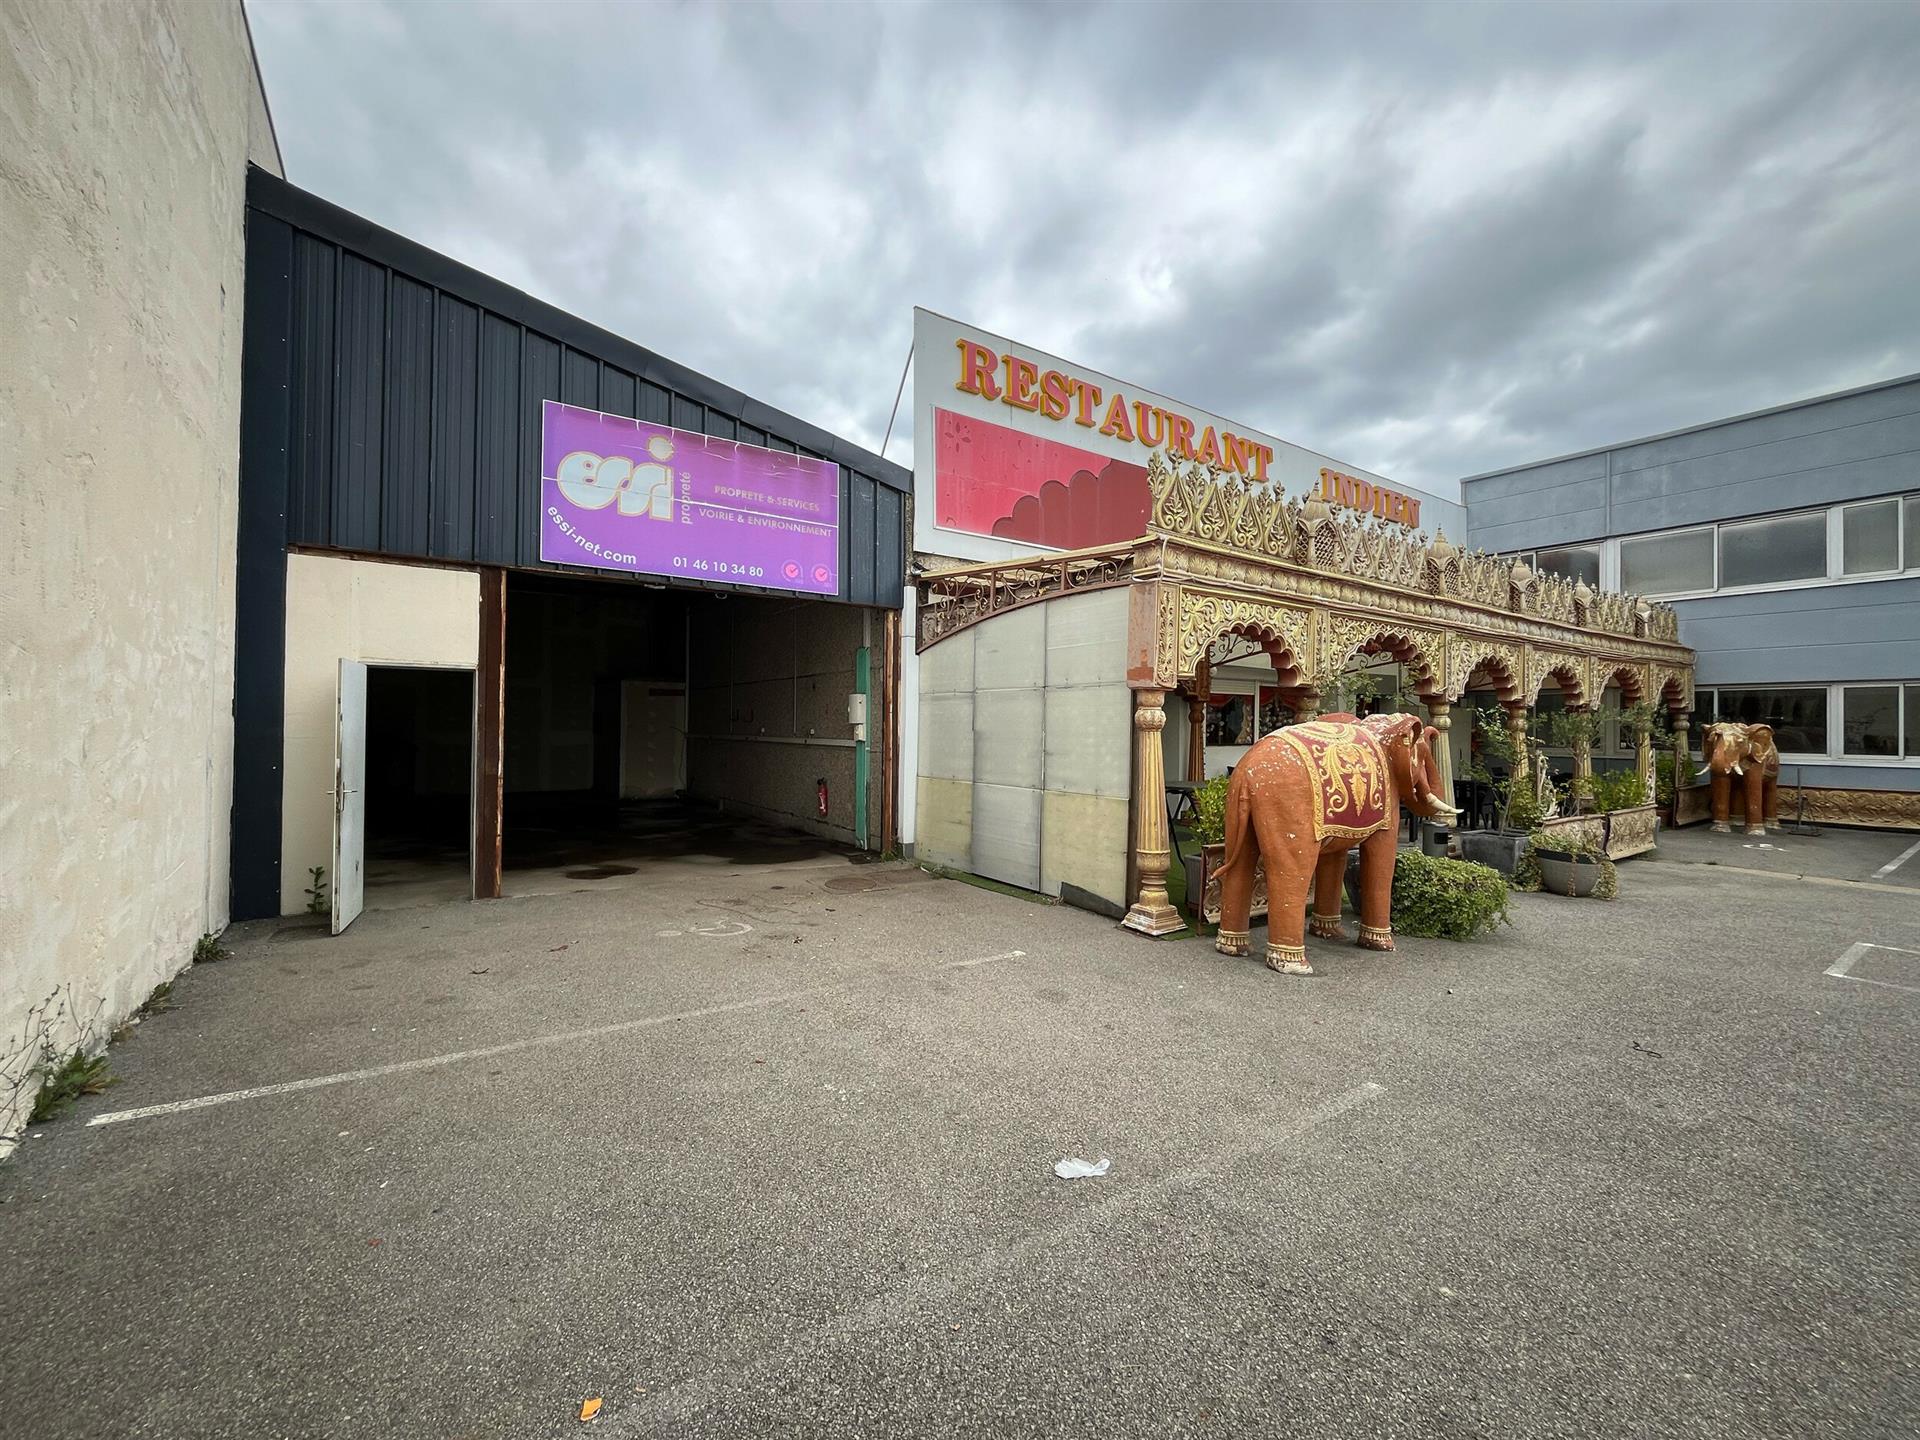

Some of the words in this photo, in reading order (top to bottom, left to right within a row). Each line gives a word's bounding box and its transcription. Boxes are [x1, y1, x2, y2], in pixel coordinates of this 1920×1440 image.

[955, 337, 1274, 483] RESTAURANT
[1319, 467, 1421, 530] INDIEN
[679, 471, 693, 525] propreté
[767, 494, 777, 504] &
[777, 496, 820, 512] SERVICES
[547, 506, 637, 565] essi-net.com
[699, 508, 734, 522] VOIRIE
[738, 514, 745, 523] &
[748, 516, 833, 537] ENVIRONNEMENT
[673, 556, 688, 568] 01
[693, 559, 708, 571] 46
[713, 561, 727, 573] 10
[731, 563, 746, 575] 34
[749, 566, 764, 577] 80
